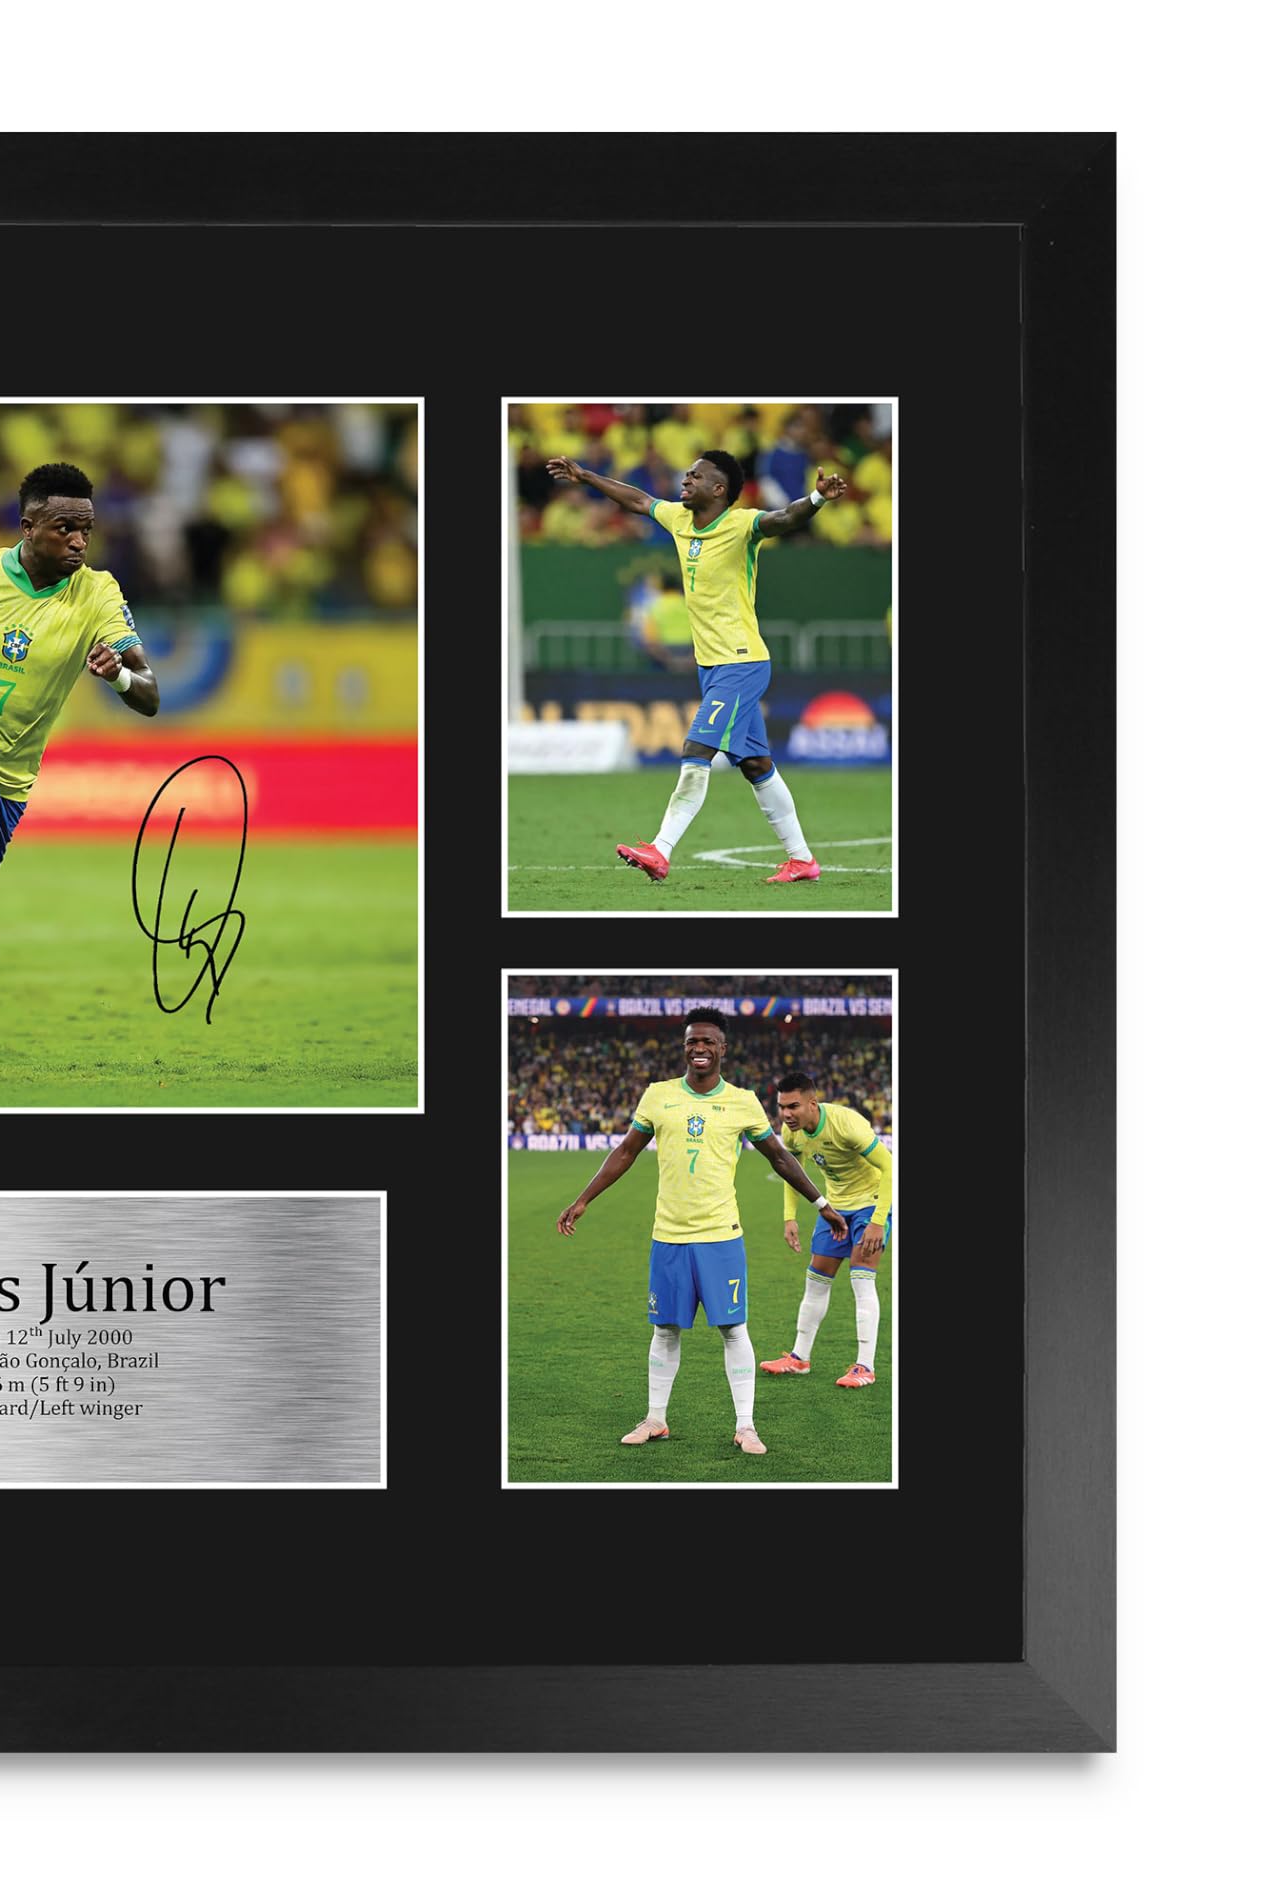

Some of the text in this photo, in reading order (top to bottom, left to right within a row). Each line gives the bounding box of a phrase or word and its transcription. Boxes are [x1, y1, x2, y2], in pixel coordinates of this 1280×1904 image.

[687, 566, 696, 593] 7
[708, 700, 726, 726] 7
[687, 1149, 700, 1175] 7
[39, 1260, 226, 1325] Júnior
[728, 1279, 740, 1304] 7
[46, 1328, 82, 1350] July
[87, 1329, 133, 1345] 2000
[26, 1352, 102, 1373] Gonçalo,
[108, 1352, 159, 1369] Brazil
[8, 1380, 25, 1392] m
[31, 1376, 49, 1396] (5
[55, 1376, 69, 1392] ft
[73, 1376, 84, 1392] 9
[90, 1376, 115, 1396] in)
[80, 1400, 143, 1421] winger
